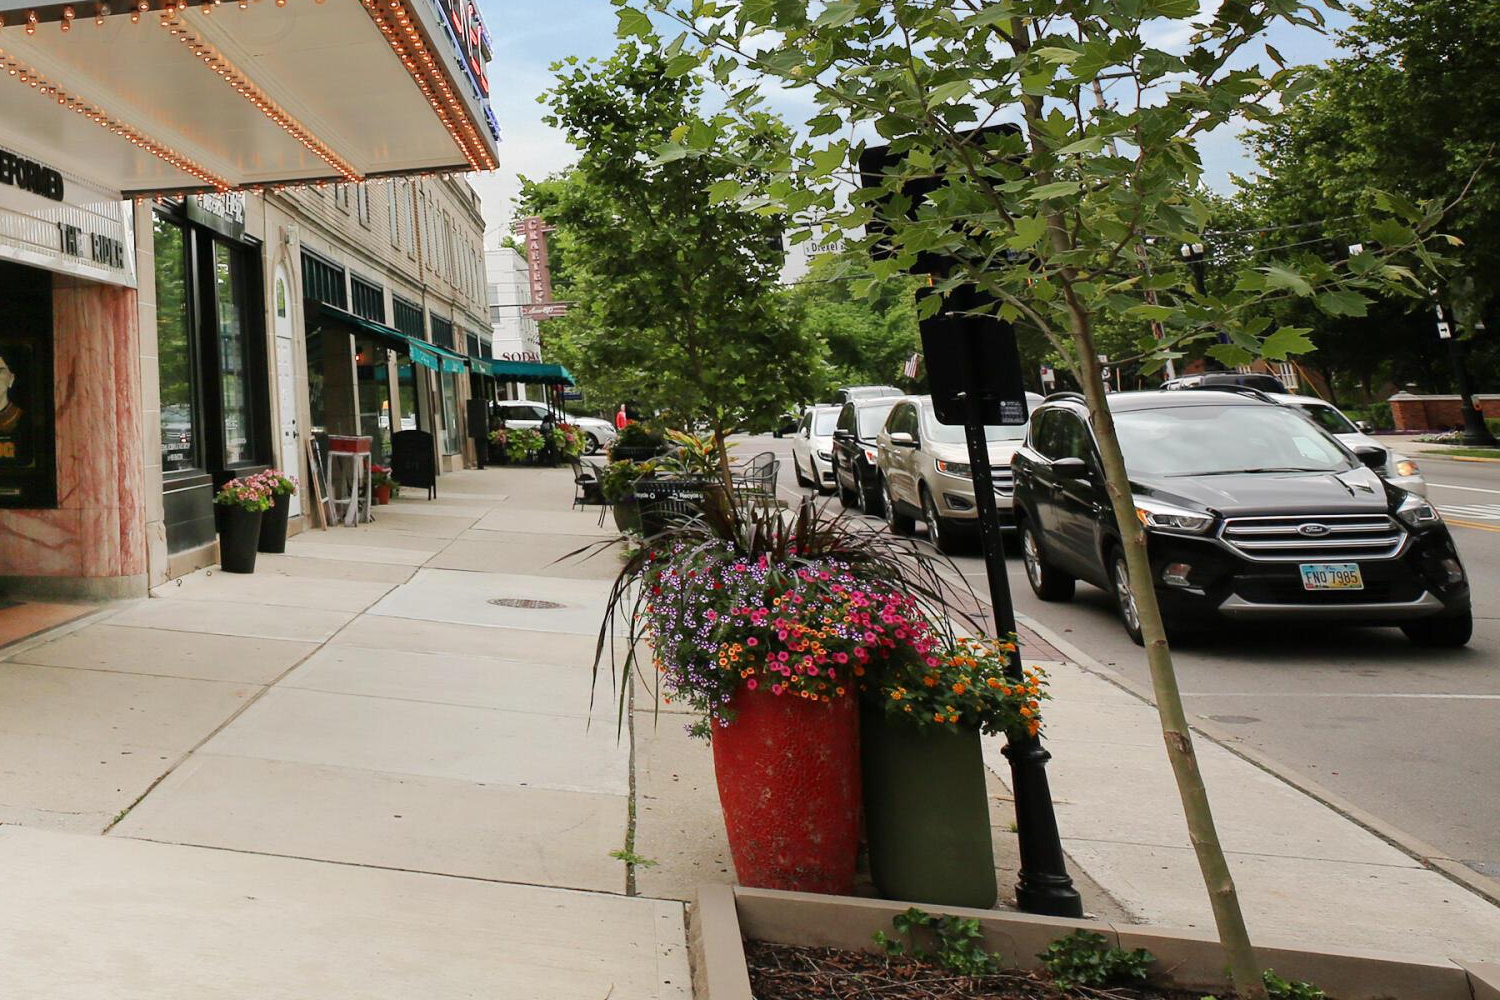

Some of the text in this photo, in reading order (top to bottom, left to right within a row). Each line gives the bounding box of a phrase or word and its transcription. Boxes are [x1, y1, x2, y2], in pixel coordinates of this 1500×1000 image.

[58, 222, 125, 269] THE RIDER
[1305, 525, 1323, 533] Ford
[1329, 571, 1358, 585] 7985
